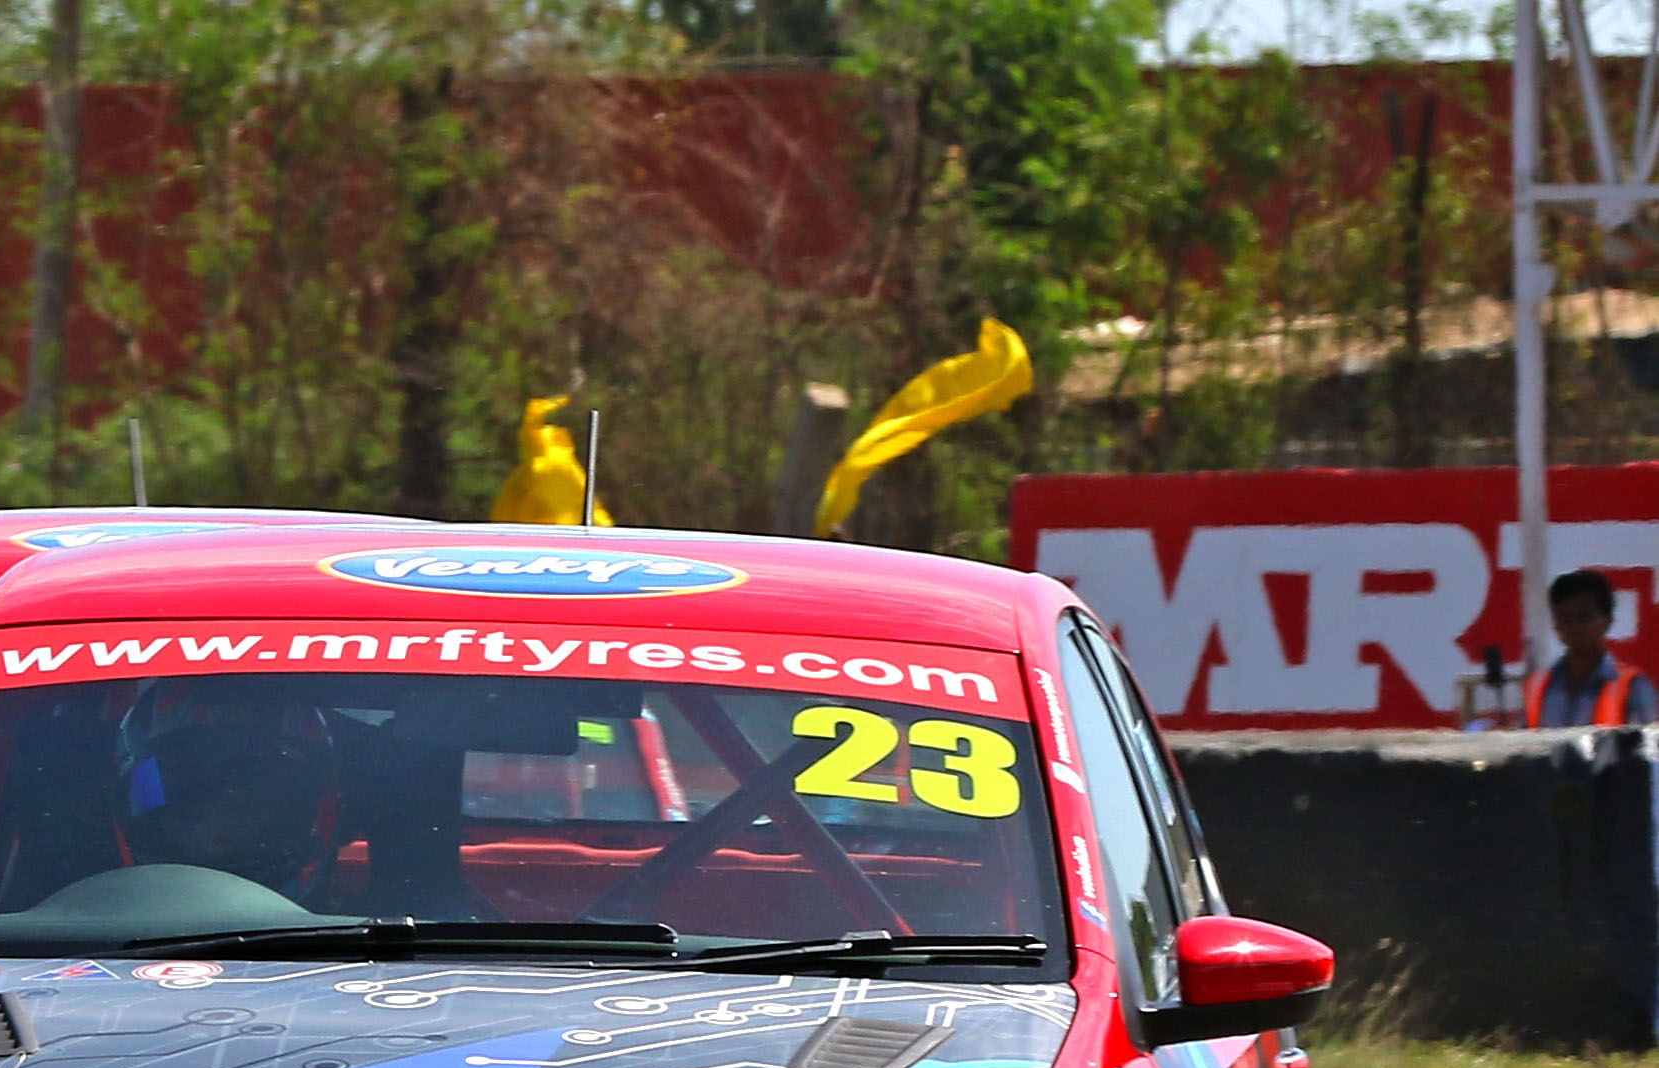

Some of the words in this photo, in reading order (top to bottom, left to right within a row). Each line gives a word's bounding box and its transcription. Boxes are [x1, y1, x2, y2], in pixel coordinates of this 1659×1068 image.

[375, 556, 692, 583] Venky's
[2, 629, 998, 703] www.mrftyres.com
[792, 706, 1022, 818] 23
